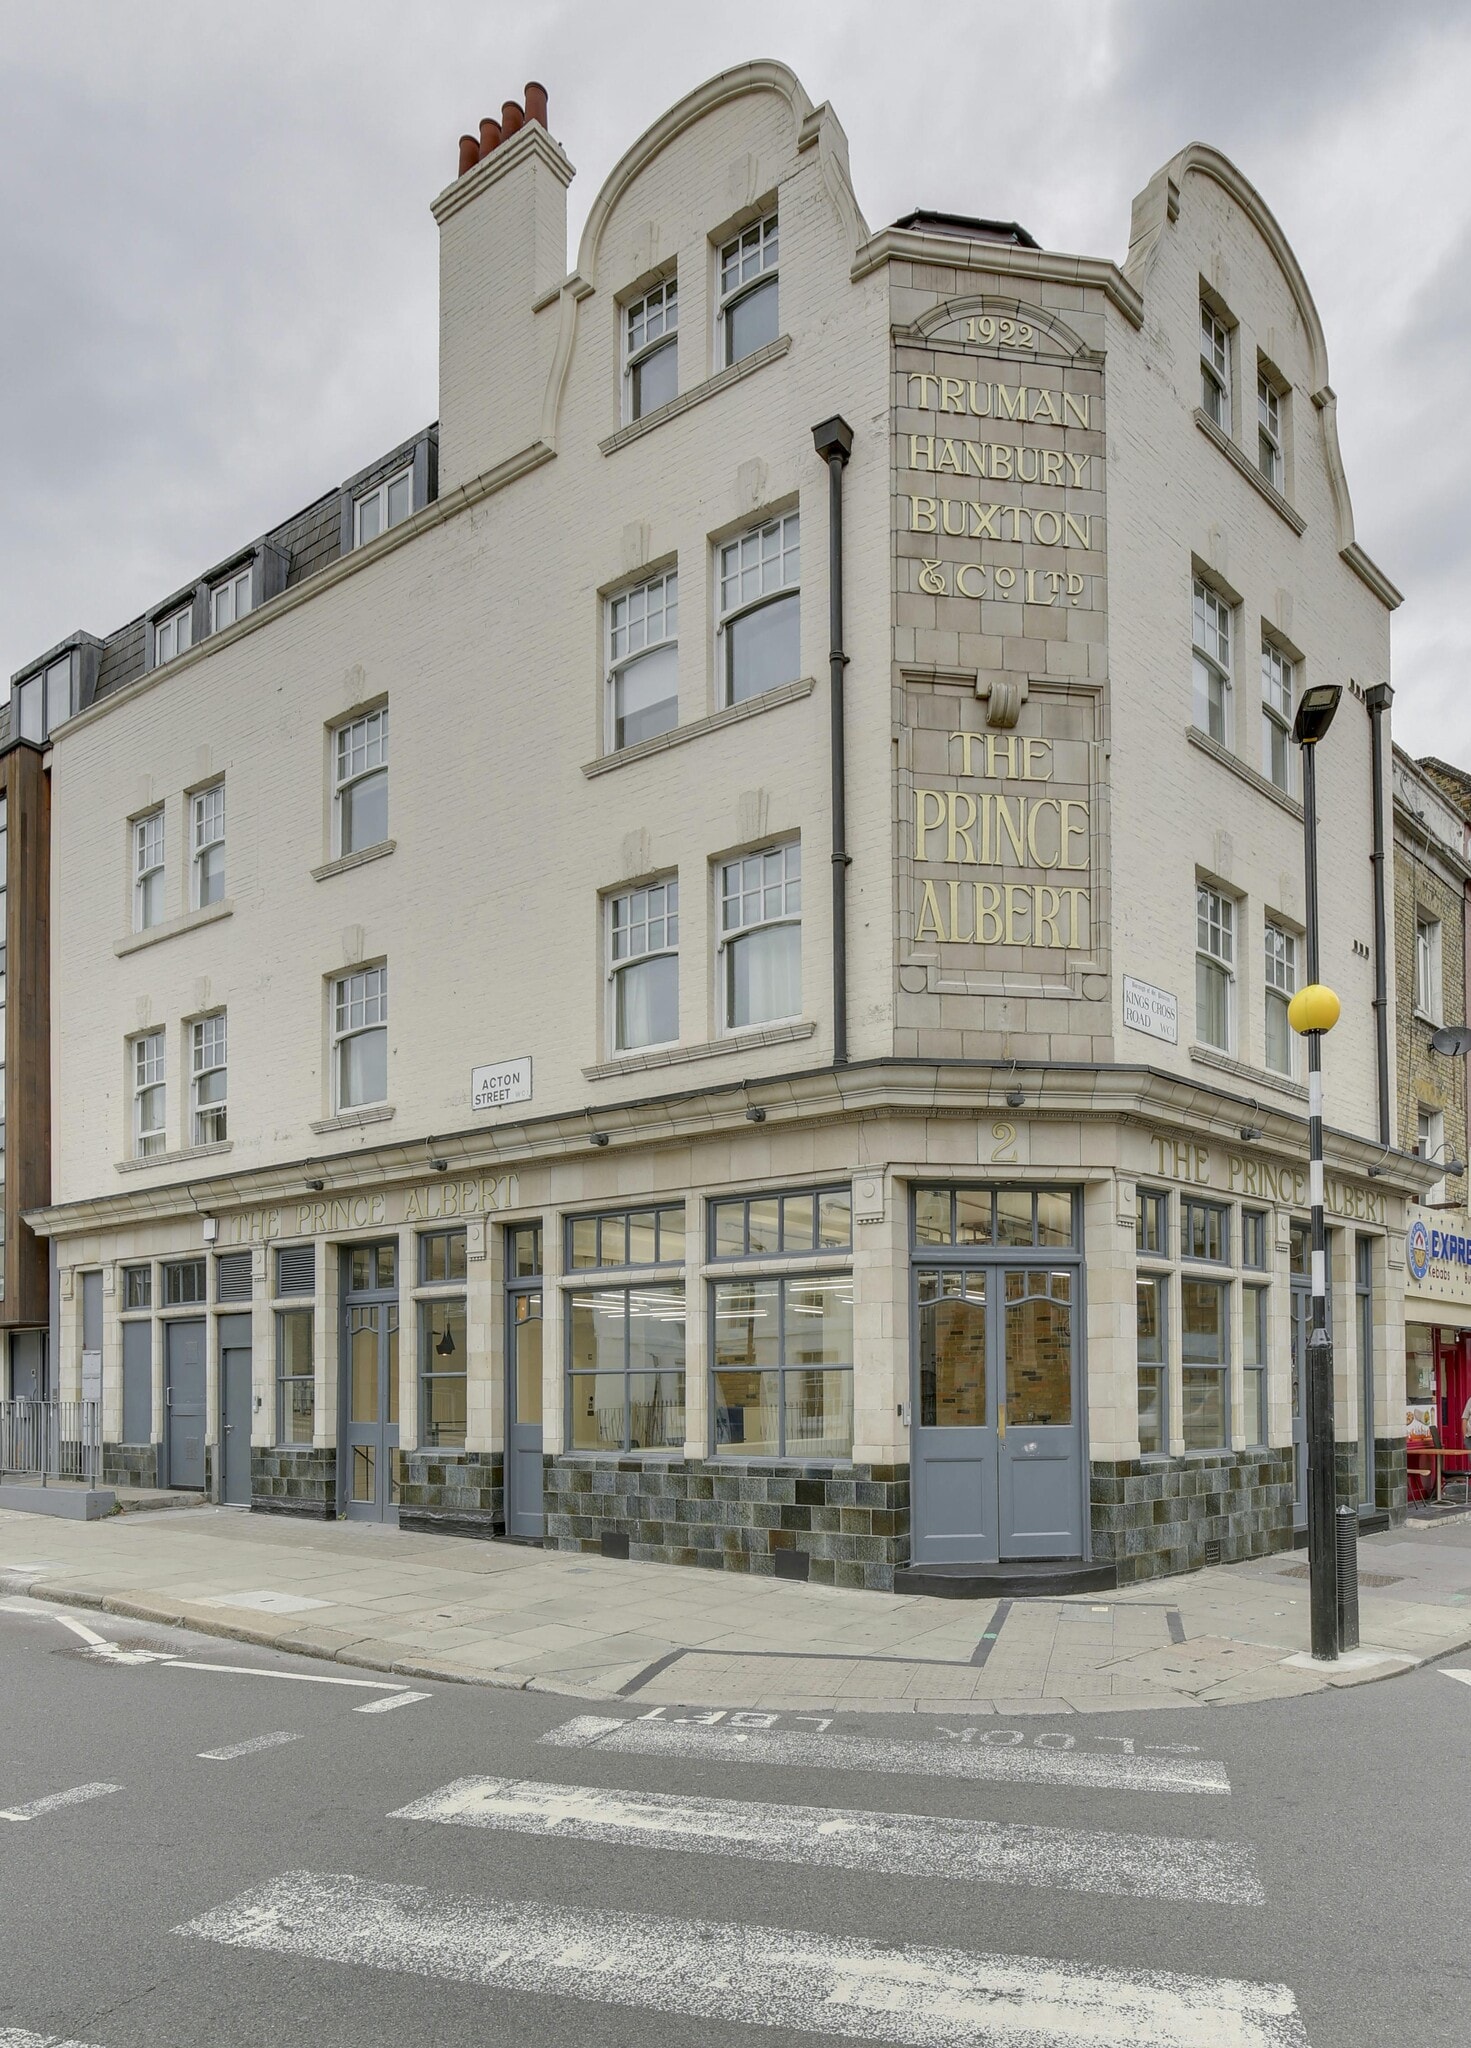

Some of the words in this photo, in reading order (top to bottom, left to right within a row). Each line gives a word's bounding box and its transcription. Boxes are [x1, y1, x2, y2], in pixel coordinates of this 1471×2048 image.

[966, 316, 1034, 349] 1922
[908, 373, 1090, 430] TRUMAN
[908, 434, 1091, 489] HANBURY
[909, 495, 1090, 550] BUXTON
[949, 731, 1053, 781] THE
[913, 788, 1091, 870] PRINCE
[914, 879, 1091, 949] ALBERT
[1125, 990, 1150, 1010] KINGS
[1151, 1000, 1176, 1021] CROSS
[1126, 1007, 1151, 1028] ROAD
[475, 1088, 511, 1105] STREET
[482, 1072, 520, 1090] ACTON
[991, 1121, 1017, 1163] 2
[1150, 1134, 1210, 1185] THE
[1227, 1154, 1306, 1206] PRINCE
[231, 1207, 280, 1243] THE
[295, 1193, 386, 1235] PRINCE
[403, 1173, 520, 1222] ALBERT
[1428, 1264, 1450, 1281] Kebabs
[935, 1726, 1135, 1755] LOOK
